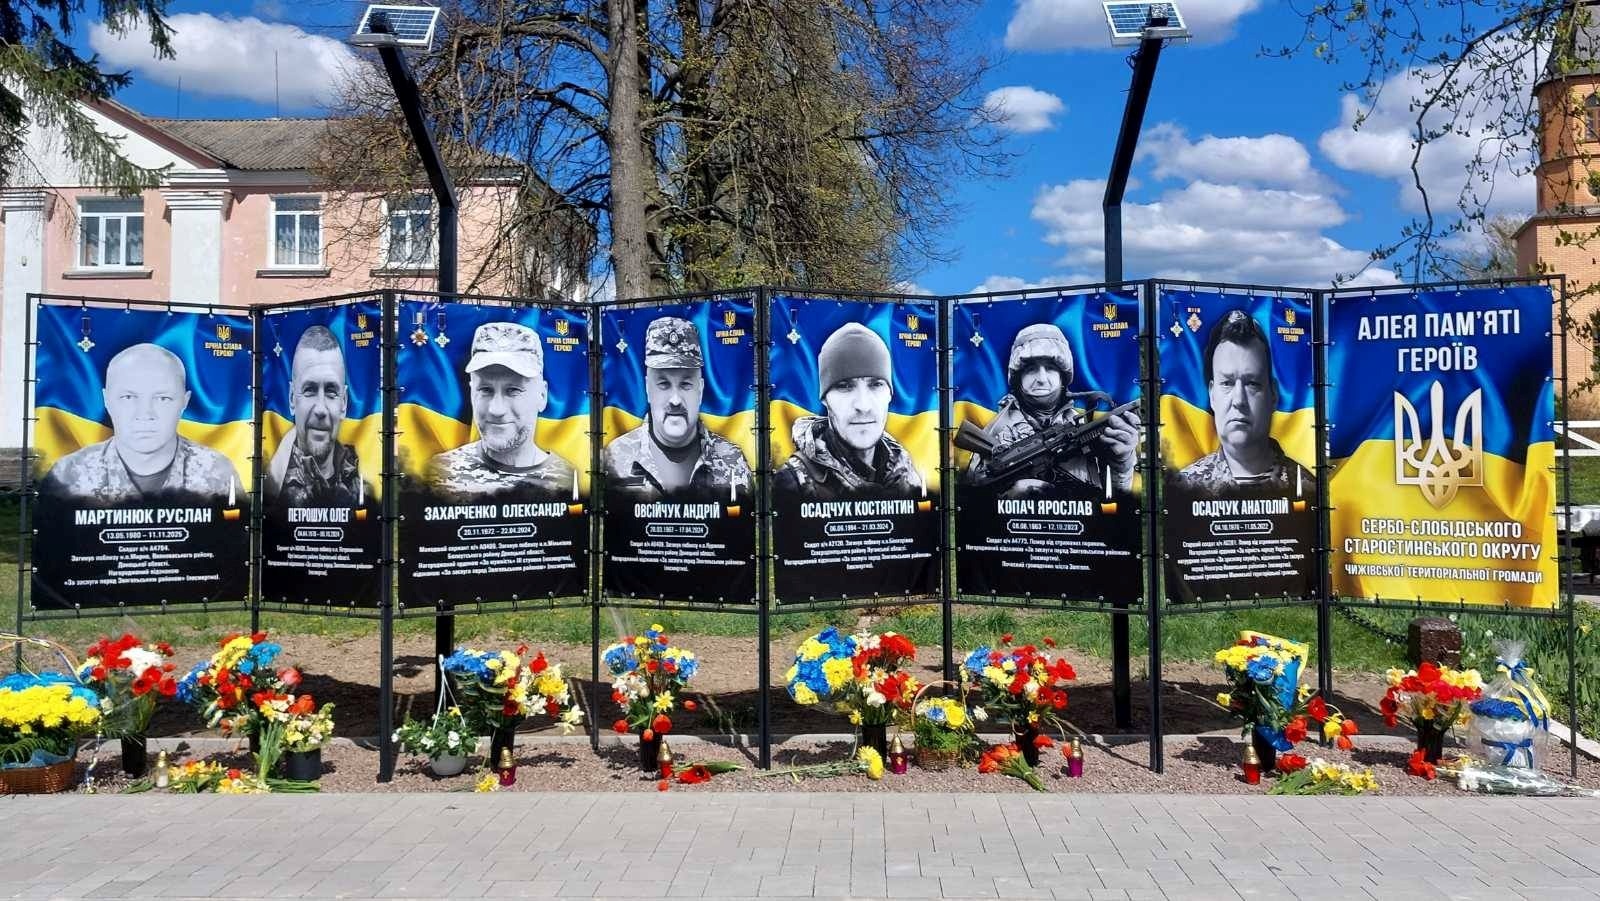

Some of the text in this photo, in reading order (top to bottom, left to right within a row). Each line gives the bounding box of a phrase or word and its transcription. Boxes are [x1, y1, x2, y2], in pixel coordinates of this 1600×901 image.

[1358, 310, 1520, 340] АЛЕЯ ПАМ’ЯТІ
[1398, 342, 1478, 372] ГЕРОЇВ
[75, 508, 211, 525] МАРТИНЮК РУСЛАН
[330, 508, 350, 522] ОЛЕГ
[424, 503, 567, 520] ЗАХАРЧЕНКО ОЛЕКСАНДР
[634, 502, 720, 519] ОВСІЙЧУК АНДРІЙ
[801, 500, 914, 518] ОСАДЧУК КОСТЯНТИН
[998, 499, 1093, 516] КОПАЧ ЯРОСЛАВ
[1192, 498, 1289, 517] ОСАДЧУК АНАТОЛІЙ
[1362, 519, 1521, 538] СЕРБО-СЛОБІДСЬКОГО
[1344, 538, 1540, 560] СТАРОСТИНСЬКОГО ОКРУГУ
[1344, 563, 1543, 584] ЧИЖІВСЬКОЇ ТЕРИТОРІАЛЬНОЇ ГРОМАДИ
